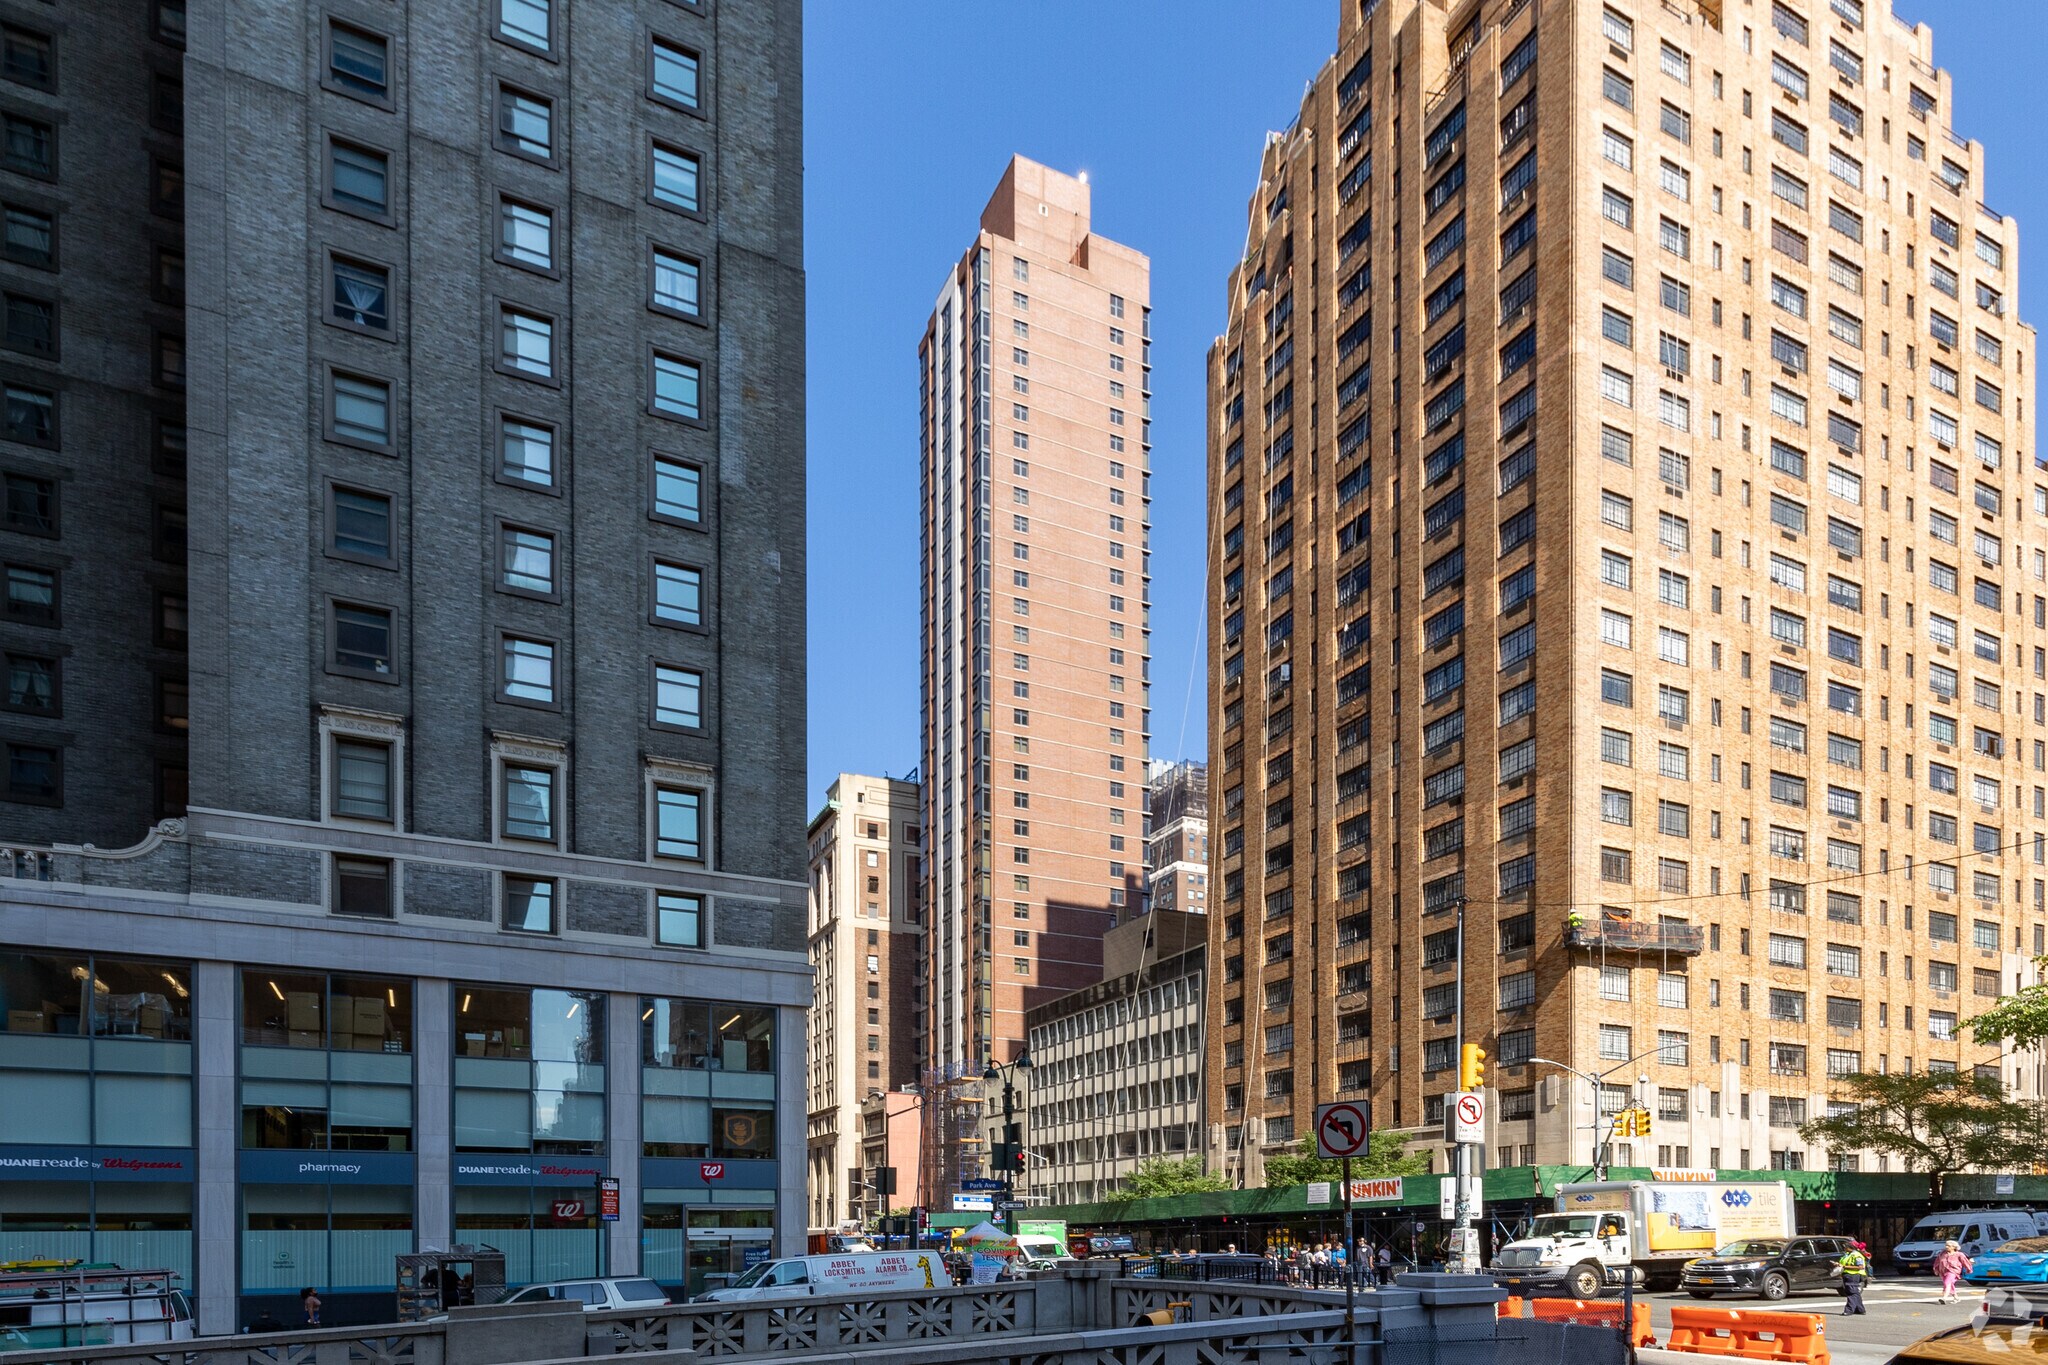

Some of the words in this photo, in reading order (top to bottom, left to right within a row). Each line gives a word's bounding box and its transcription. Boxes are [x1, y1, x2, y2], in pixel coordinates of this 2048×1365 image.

[103, 1158, 183, 1171] Walgreens
[299, 1162, 361, 1174] pharmacy
[1653, 1170, 1714, 1182] DUNKIN'
[1344, 1180, 1400, 1198] UNKIN'
[1758, 1191, 1777, 1206] tile
[831, 1260, 856, 1269] ABBEY
[881, 1257, 906, 1265] ABBEY
[824, 1267, 866, 1277] LOCKSMITHS
[875, 1265, 897, 1274] ALARM
[899, 1264, 910, 1272] CO.
